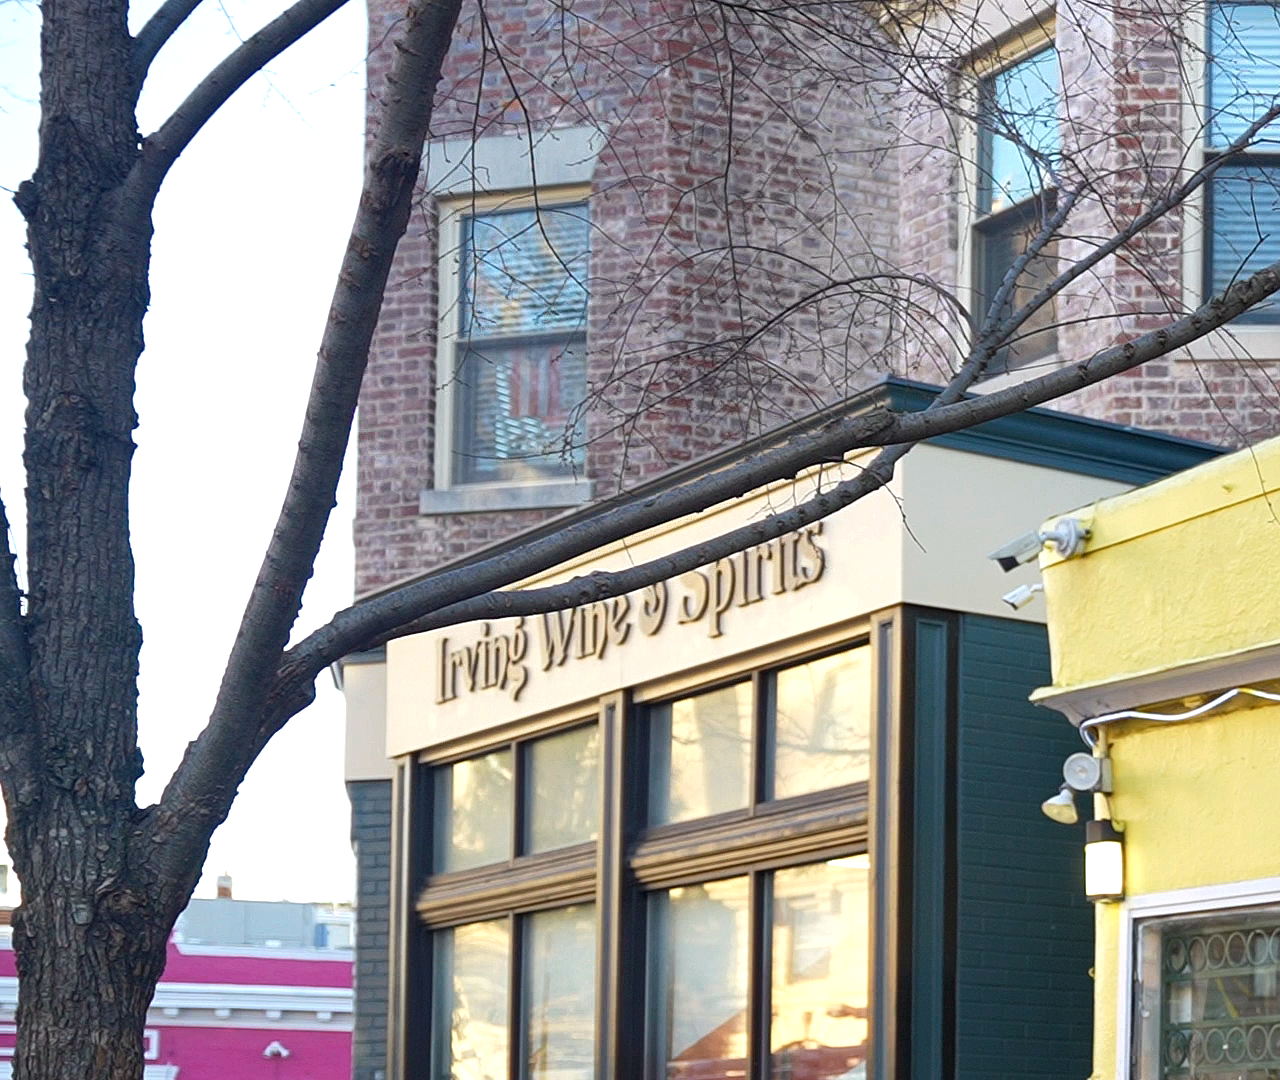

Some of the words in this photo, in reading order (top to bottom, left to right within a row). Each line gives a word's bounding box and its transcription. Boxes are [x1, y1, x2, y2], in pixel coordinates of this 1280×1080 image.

[434, 616, 528, 705] Irving
[538, 594, 633, 672] Wine
[677, 521, 826, 640] Spirits
